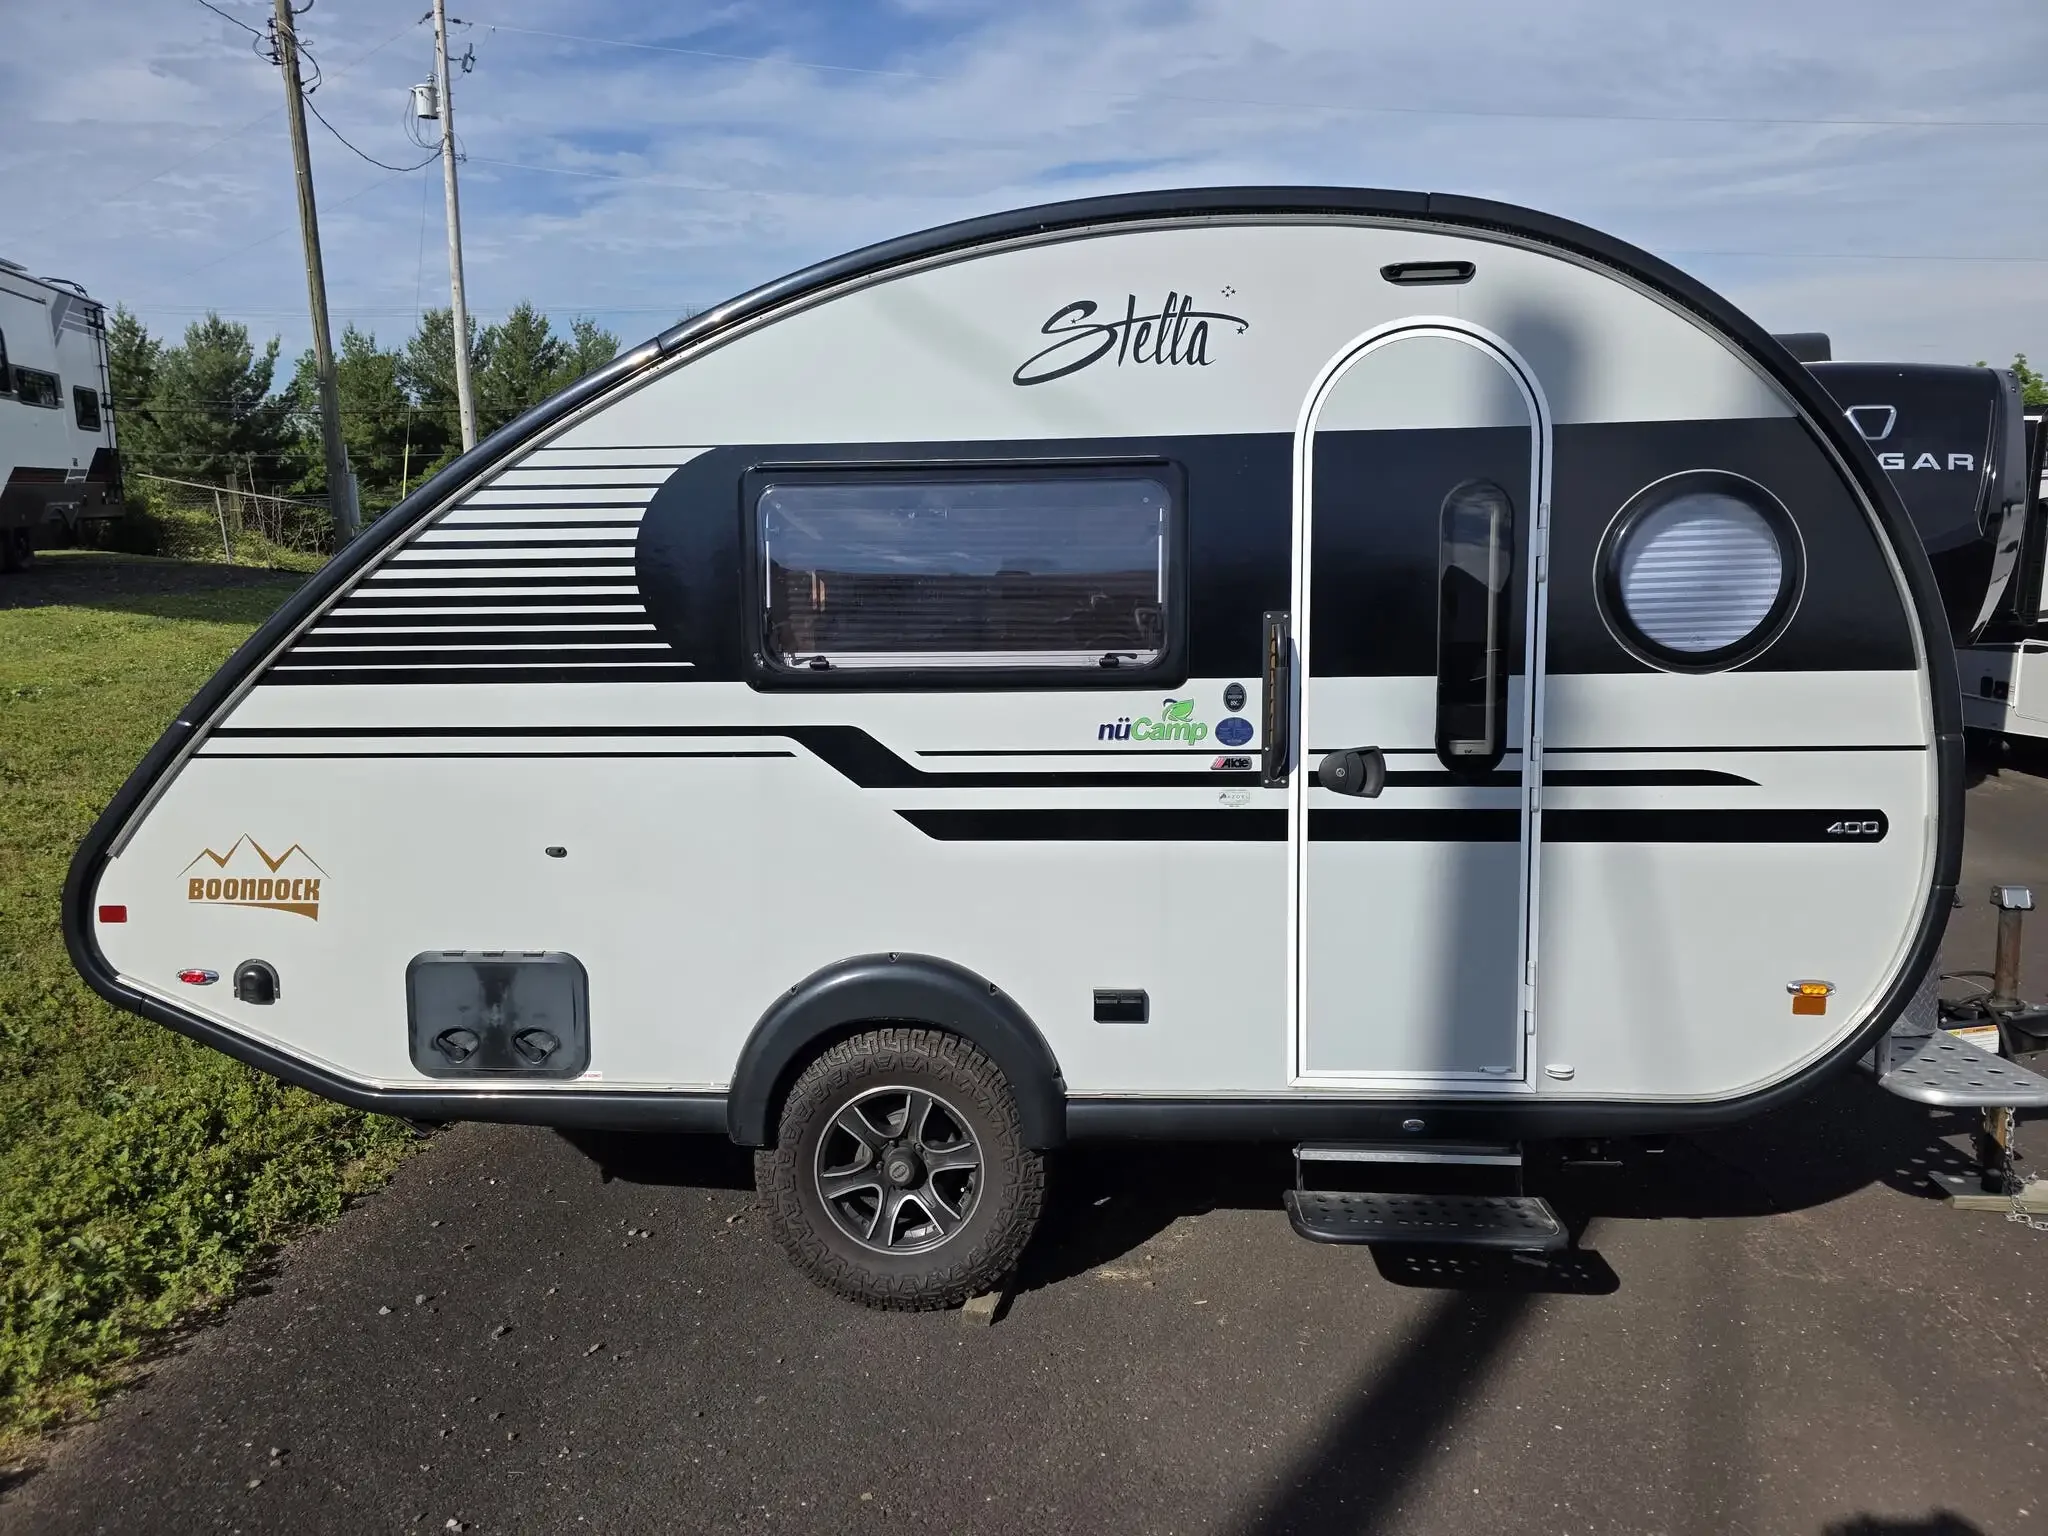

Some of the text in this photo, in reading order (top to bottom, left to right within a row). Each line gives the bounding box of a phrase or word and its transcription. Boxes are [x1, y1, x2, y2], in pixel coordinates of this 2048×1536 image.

[1013, 291, 1249, 386] Stella
[1098, 717, 1208, 746] nüCamp
[1221, 757, 1249, 768] Alde
[1826, 821, 1879, 834] 400
[188, 878, 321, 901] BOONDOCK
